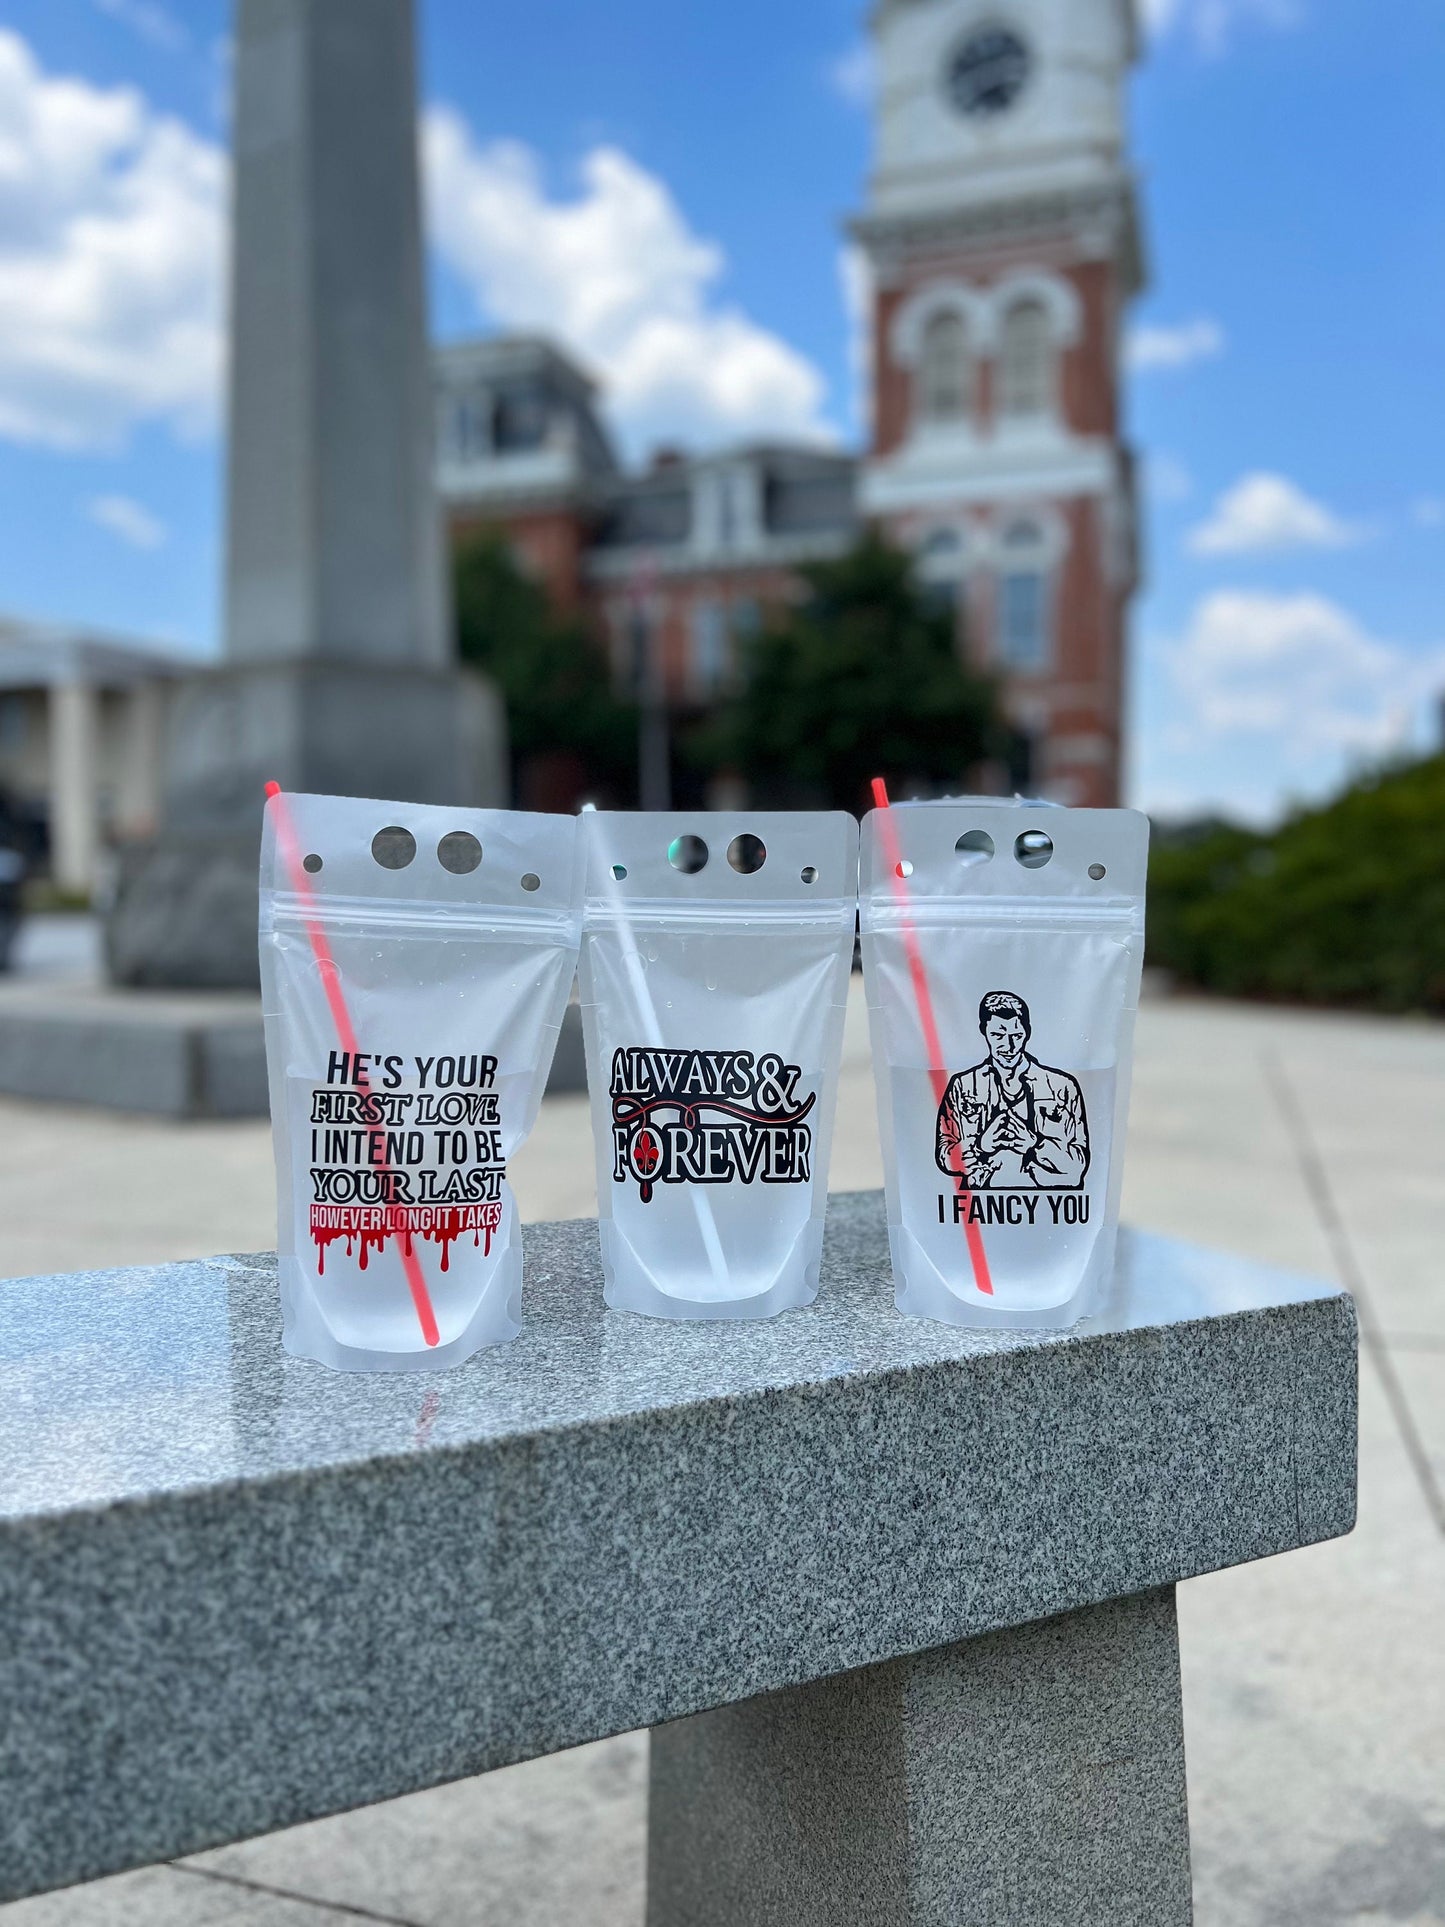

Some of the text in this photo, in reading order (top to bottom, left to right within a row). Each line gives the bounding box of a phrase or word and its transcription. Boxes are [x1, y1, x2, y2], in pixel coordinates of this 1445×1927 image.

[327, 1051, 498, 1088] HE'S YOUR
[609, 1047, 801, 1115] ALWAYS &
[310, 1090, 500, 1125] FIRST LOVE
[311, 1129, 505, 1165] I INTEND TO BE
[612, 1123, 811, 1184] FOREVER
[310, 1166, 506, 1204] YOUR LAST
[311, 1202, 501, 1230] HOWEVER LONG IT TAKES
[938, 1194, 1090, 1225] I FANCY YOU
